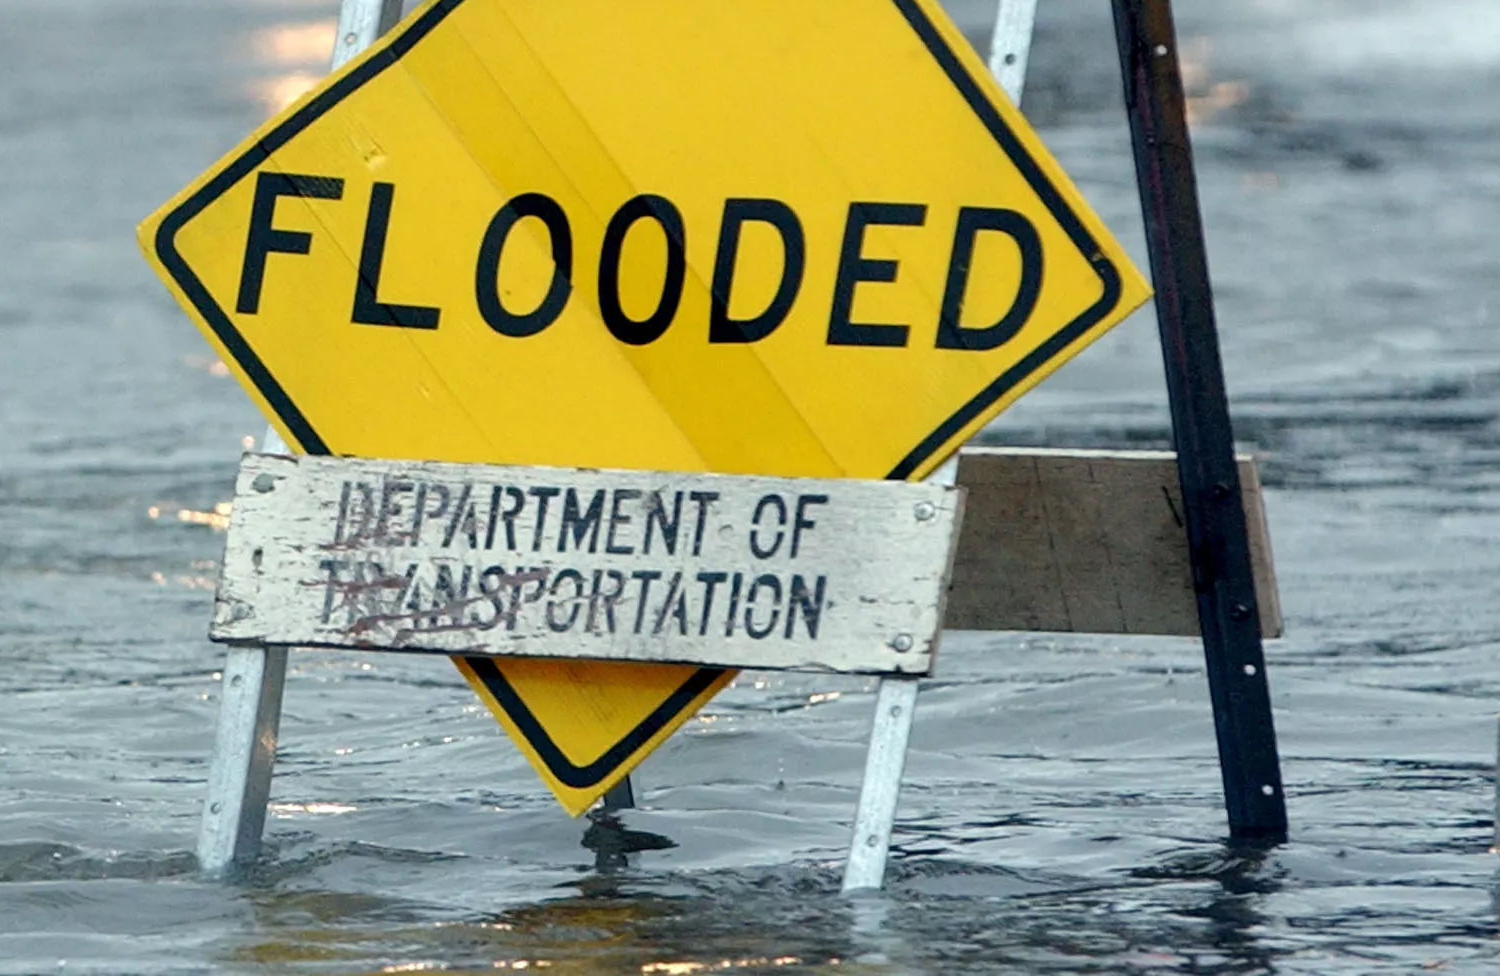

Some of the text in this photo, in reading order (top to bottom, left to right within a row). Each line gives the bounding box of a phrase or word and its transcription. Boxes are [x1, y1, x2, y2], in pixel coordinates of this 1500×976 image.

[236, 171, 1045, 351] FLOODED
[334, 480, 829, 560] DEPARTMENT OF
